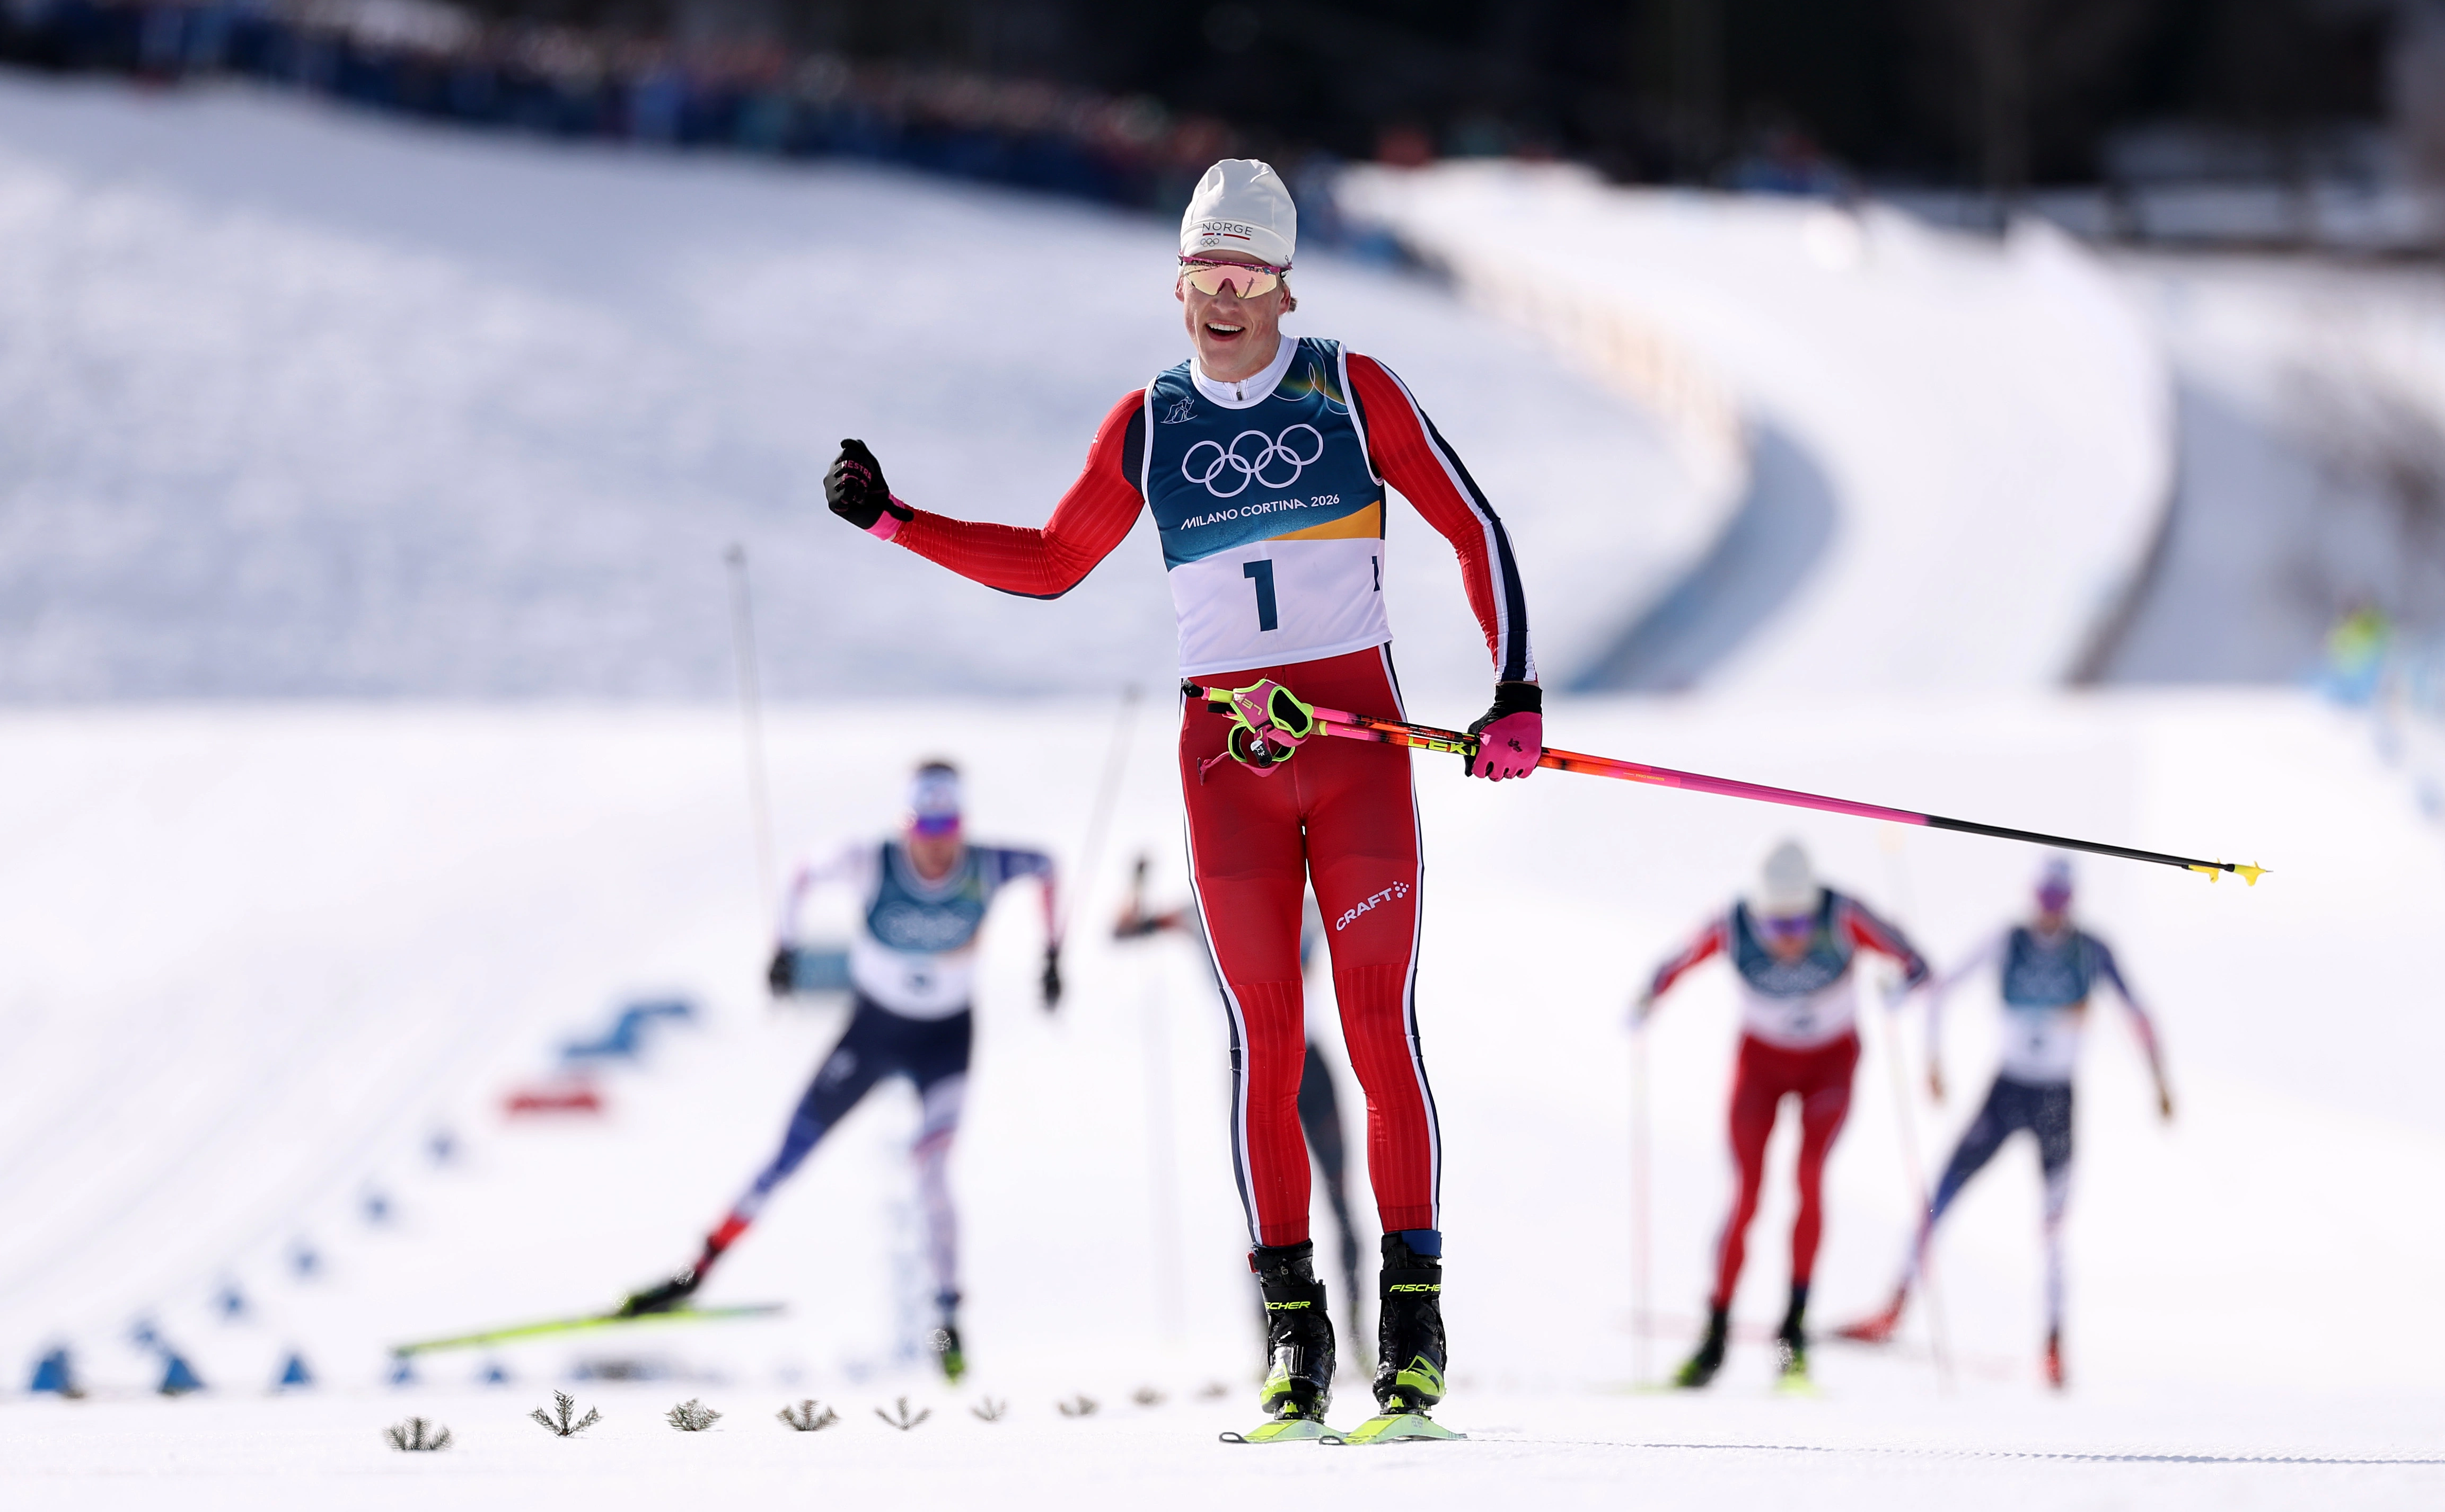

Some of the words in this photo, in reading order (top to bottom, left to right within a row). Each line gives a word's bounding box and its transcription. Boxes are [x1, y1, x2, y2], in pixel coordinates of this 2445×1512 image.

[1202, 222, 1253, 236] NORGE
[841, 460, 872, 482] HESTRA
[1181, 509, 1238, 530] MILANO
[1241, 499, 1307, 517] CORTINA
[1311, 494, 1340, 507] 2026
[1243, 559, 1278, 632] 1
[1408, 736, 1476, 756] LEKI
[1336, 888, 1392, 931] CRAFT
